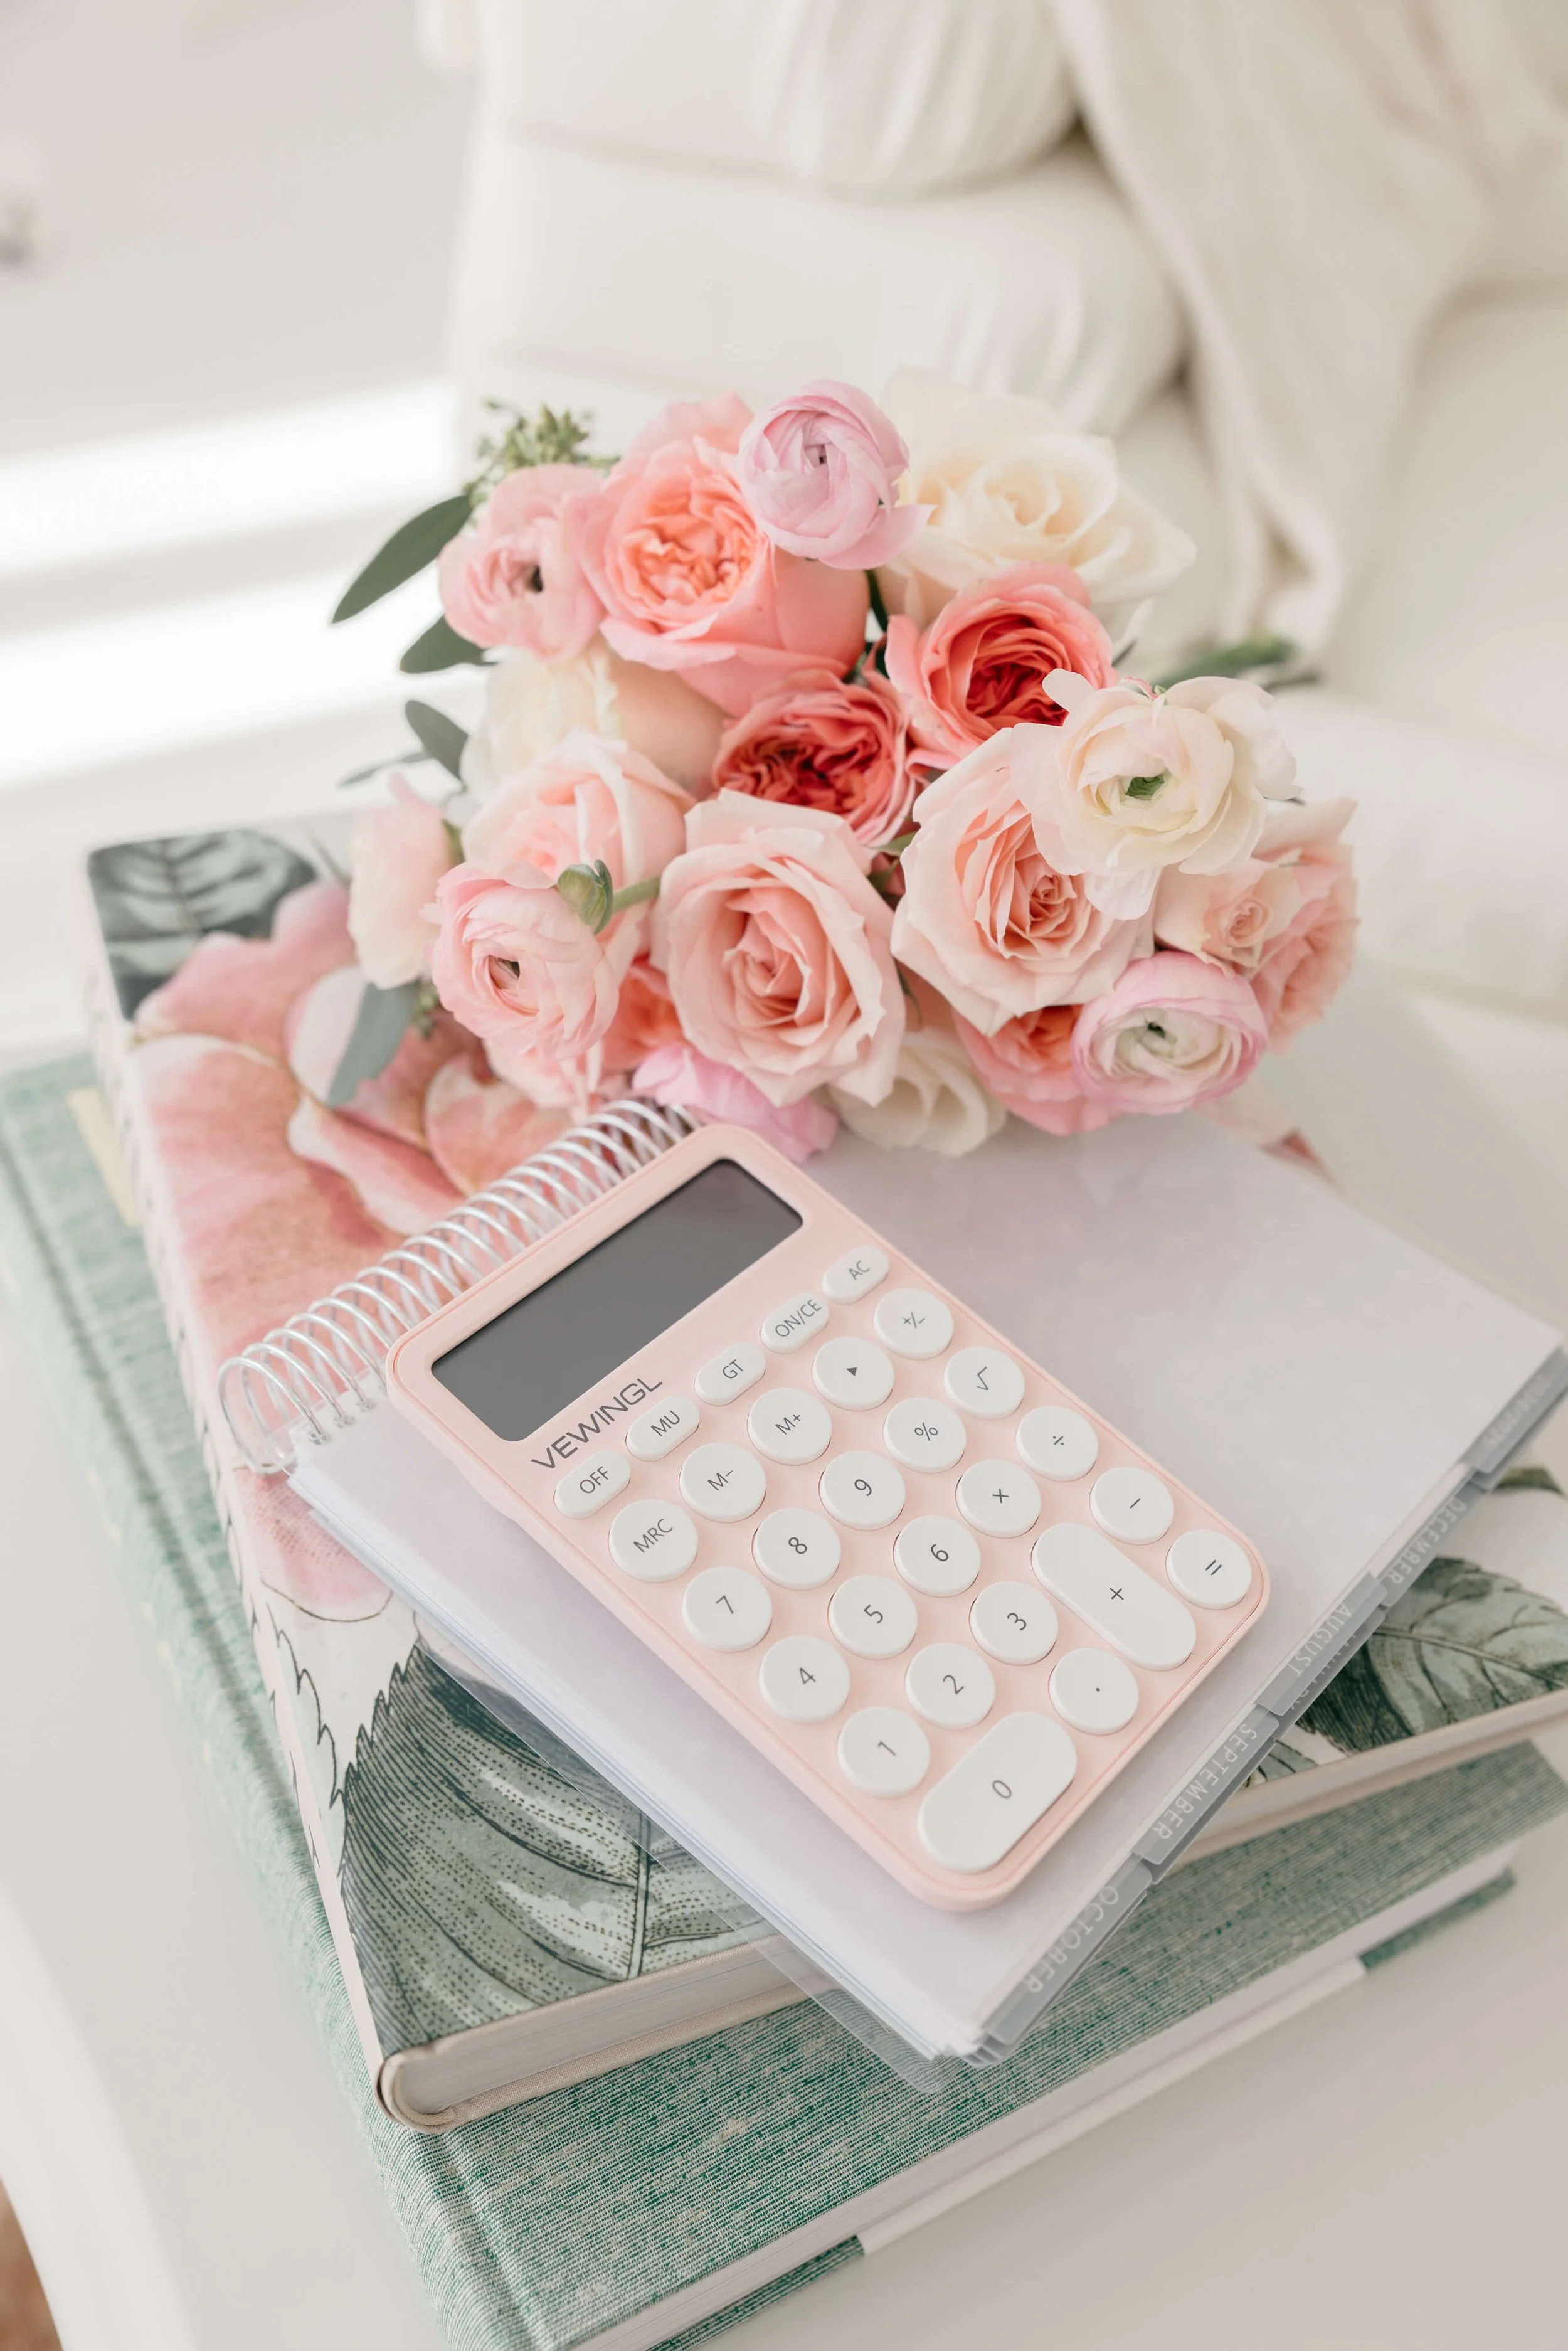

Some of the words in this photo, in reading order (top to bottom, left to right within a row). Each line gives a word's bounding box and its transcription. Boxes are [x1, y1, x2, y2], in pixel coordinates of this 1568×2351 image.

[848, 1260, 871, 1281] AC
[775, 1298, 822, 1338] ON/CE
[723, 1359, 743, 1379] GT
[531, 1377, 664, 1470] VEWINGL
[650, 1410, 681, 1438] MU
[775, 1414, 801, 1435] M+
[914, 1422, 938, 1441] %
[579, 1466, 610, 1495] OFF
[854, 1478, 872, 1497] 9
[633, 1518, 673, 1553] MRC
[1391, 1498, 1466, 1584] DECEMBER
[788, 1537, 808, 1555] 8
[930, 1544, 949, 1562] 6
[1205, 1559, 1222, 1576] =
[1109, 1588, 1125, 1600] +
[716, 1595, 734, 1615] 7
[863, 1604, 884, 1624] 5
[1007, 1612, 1027, 1631] 3
[1288, 1603, 1352, 1677] AUGUST
[799, 1667, 816, 1685] 4
[942, 1674, 965, 1695] 2
[877, 1741, 896, 1756] 1
[992, 1780, 1012, 1800] 0
[1152, 1722, 1257, 1840] SEPTEMBER
[1023, 1885, 1119, 1993] OCTOBER
